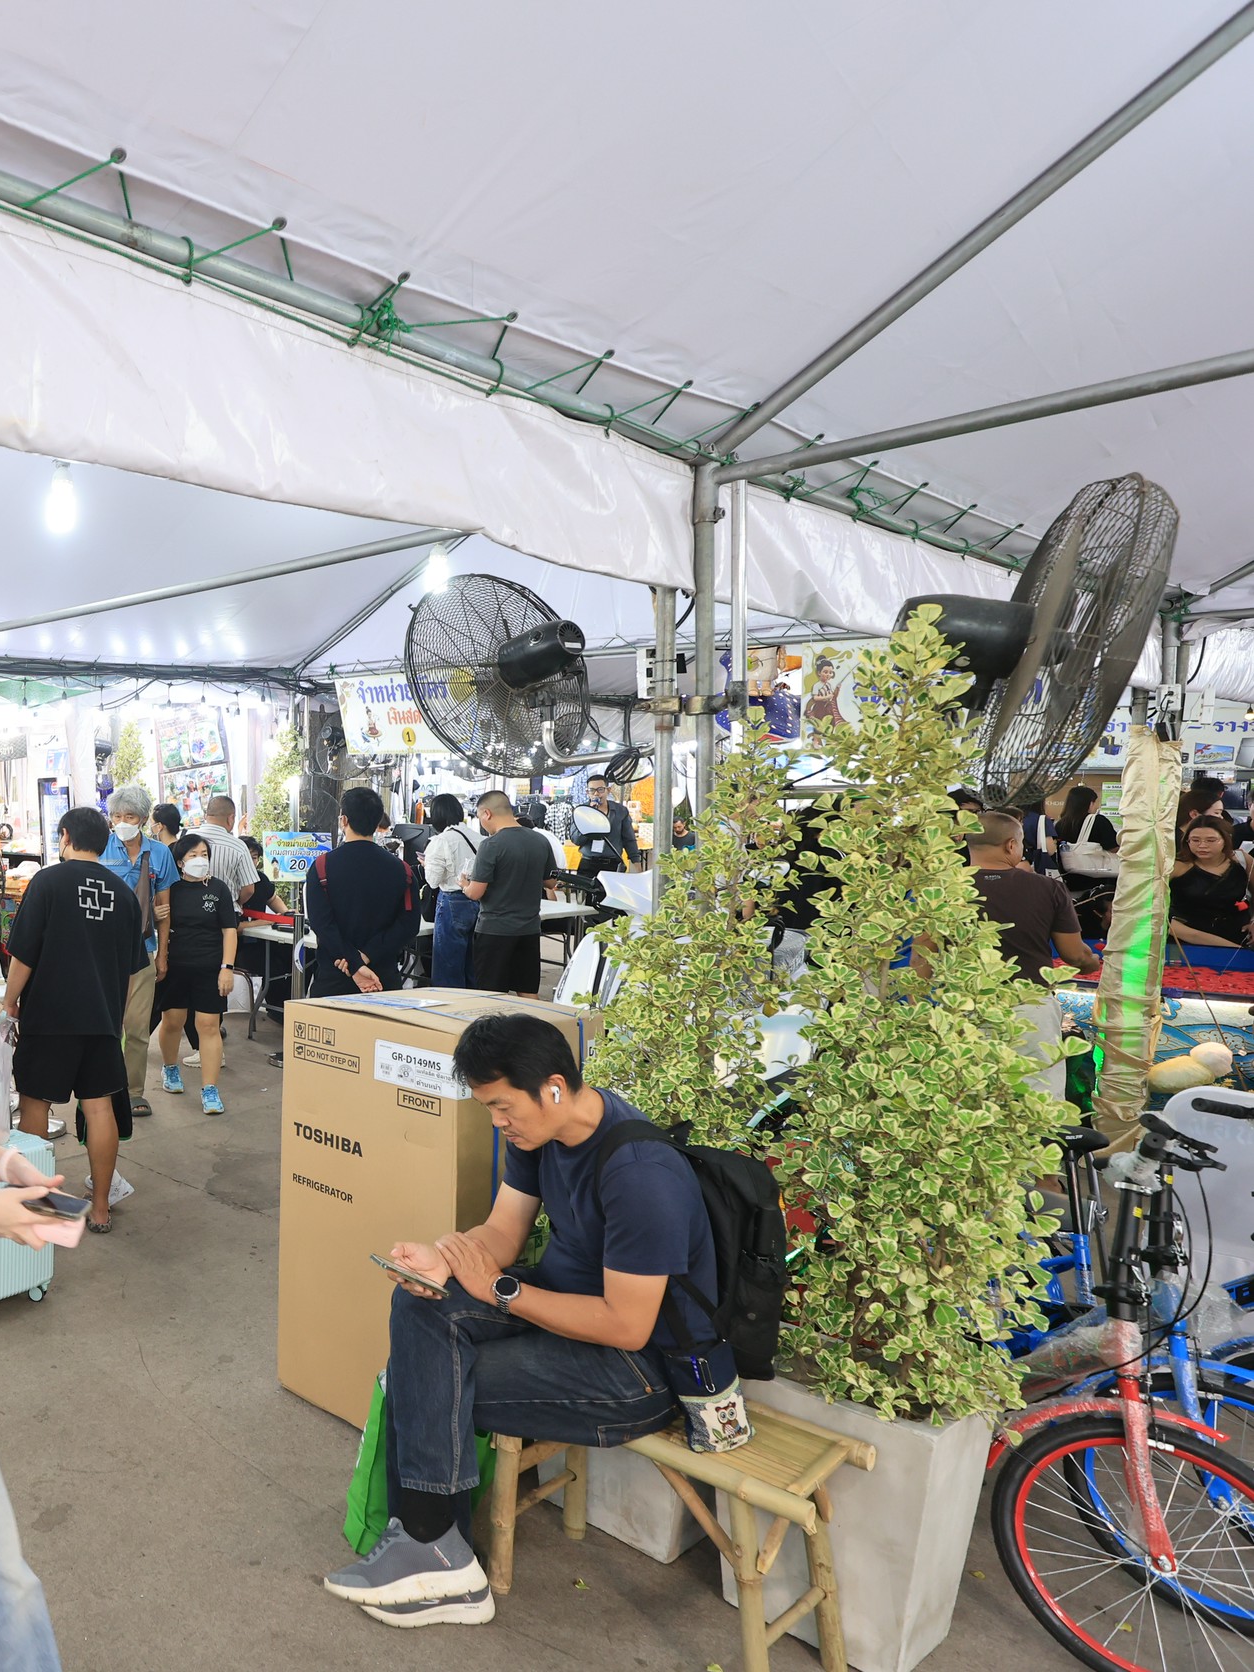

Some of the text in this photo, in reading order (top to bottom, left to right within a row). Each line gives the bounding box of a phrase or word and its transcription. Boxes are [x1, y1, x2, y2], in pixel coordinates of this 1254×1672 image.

[289, 859, 307, 870] 20
[306, 1049, 358, 1068] DO NOT STEP ON
[391, 1051, 441, 1071] GR-D149MS
[416, 1079, 442, 1092] ด้านหน้า
[402, 1094, 436, 1111] FRONT
[294, 1121, 363, 1158] TOSHIBA
[292, 1172, 354, 1204] REFRIGERATOR
